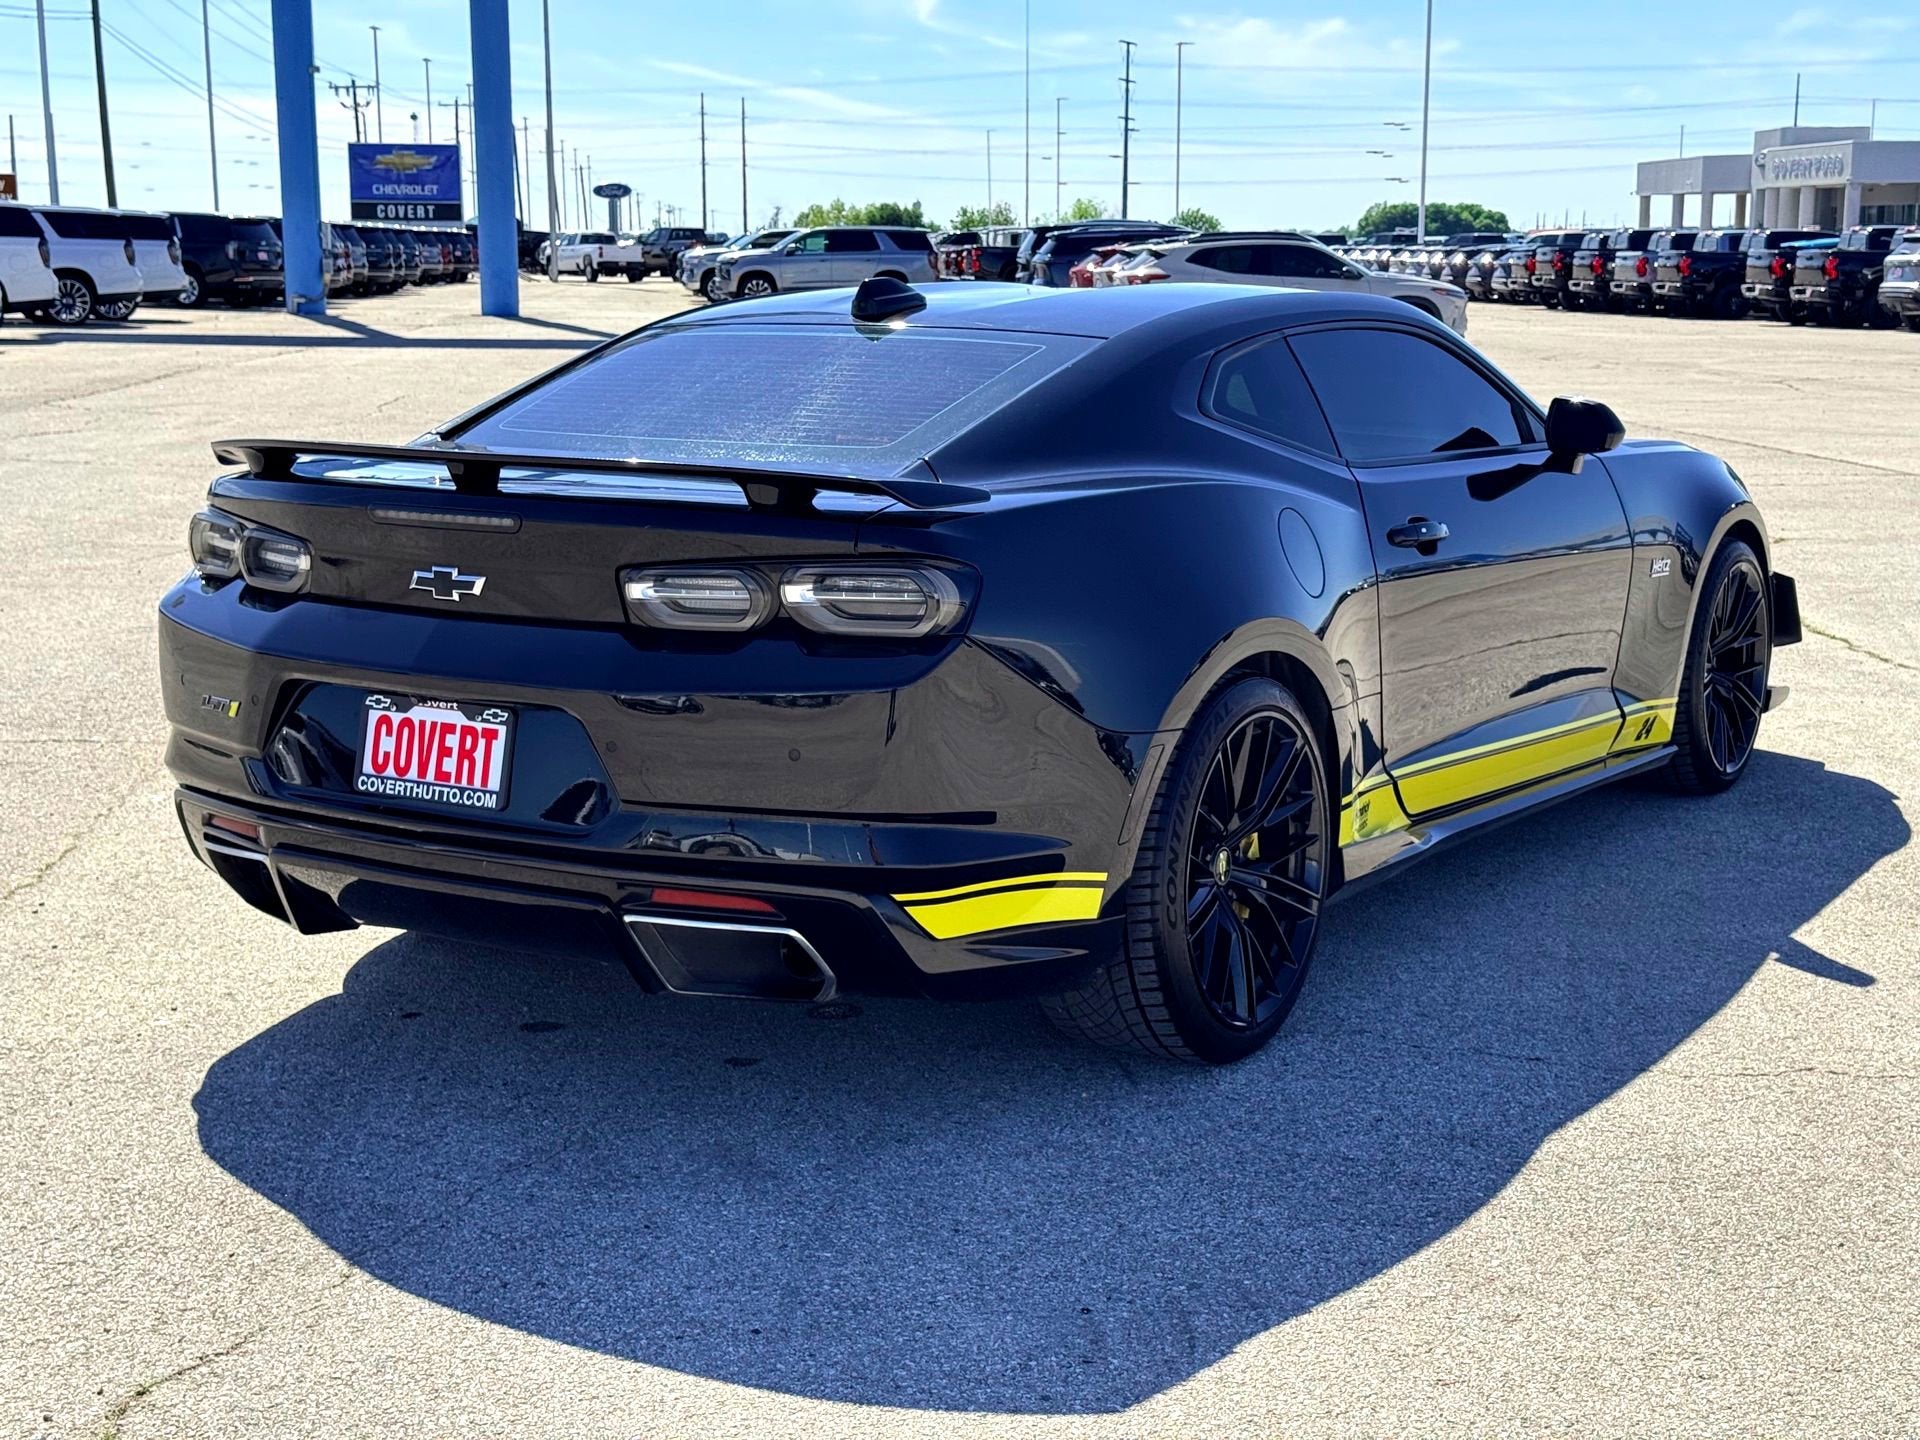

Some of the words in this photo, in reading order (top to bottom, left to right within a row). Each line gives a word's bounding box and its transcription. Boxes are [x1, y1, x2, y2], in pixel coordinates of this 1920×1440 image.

[371, 183, 439, 196] CHEVROLET
[376, 204, 436, 219] COVERT
[1634, 715, 1658, 741] 24
[371, 713, 499, 789] COVERT
[357, 775, 497, 809] COVERTHUTTO.COM
[1165, 702, 1234, 930] CONTINENTAL
